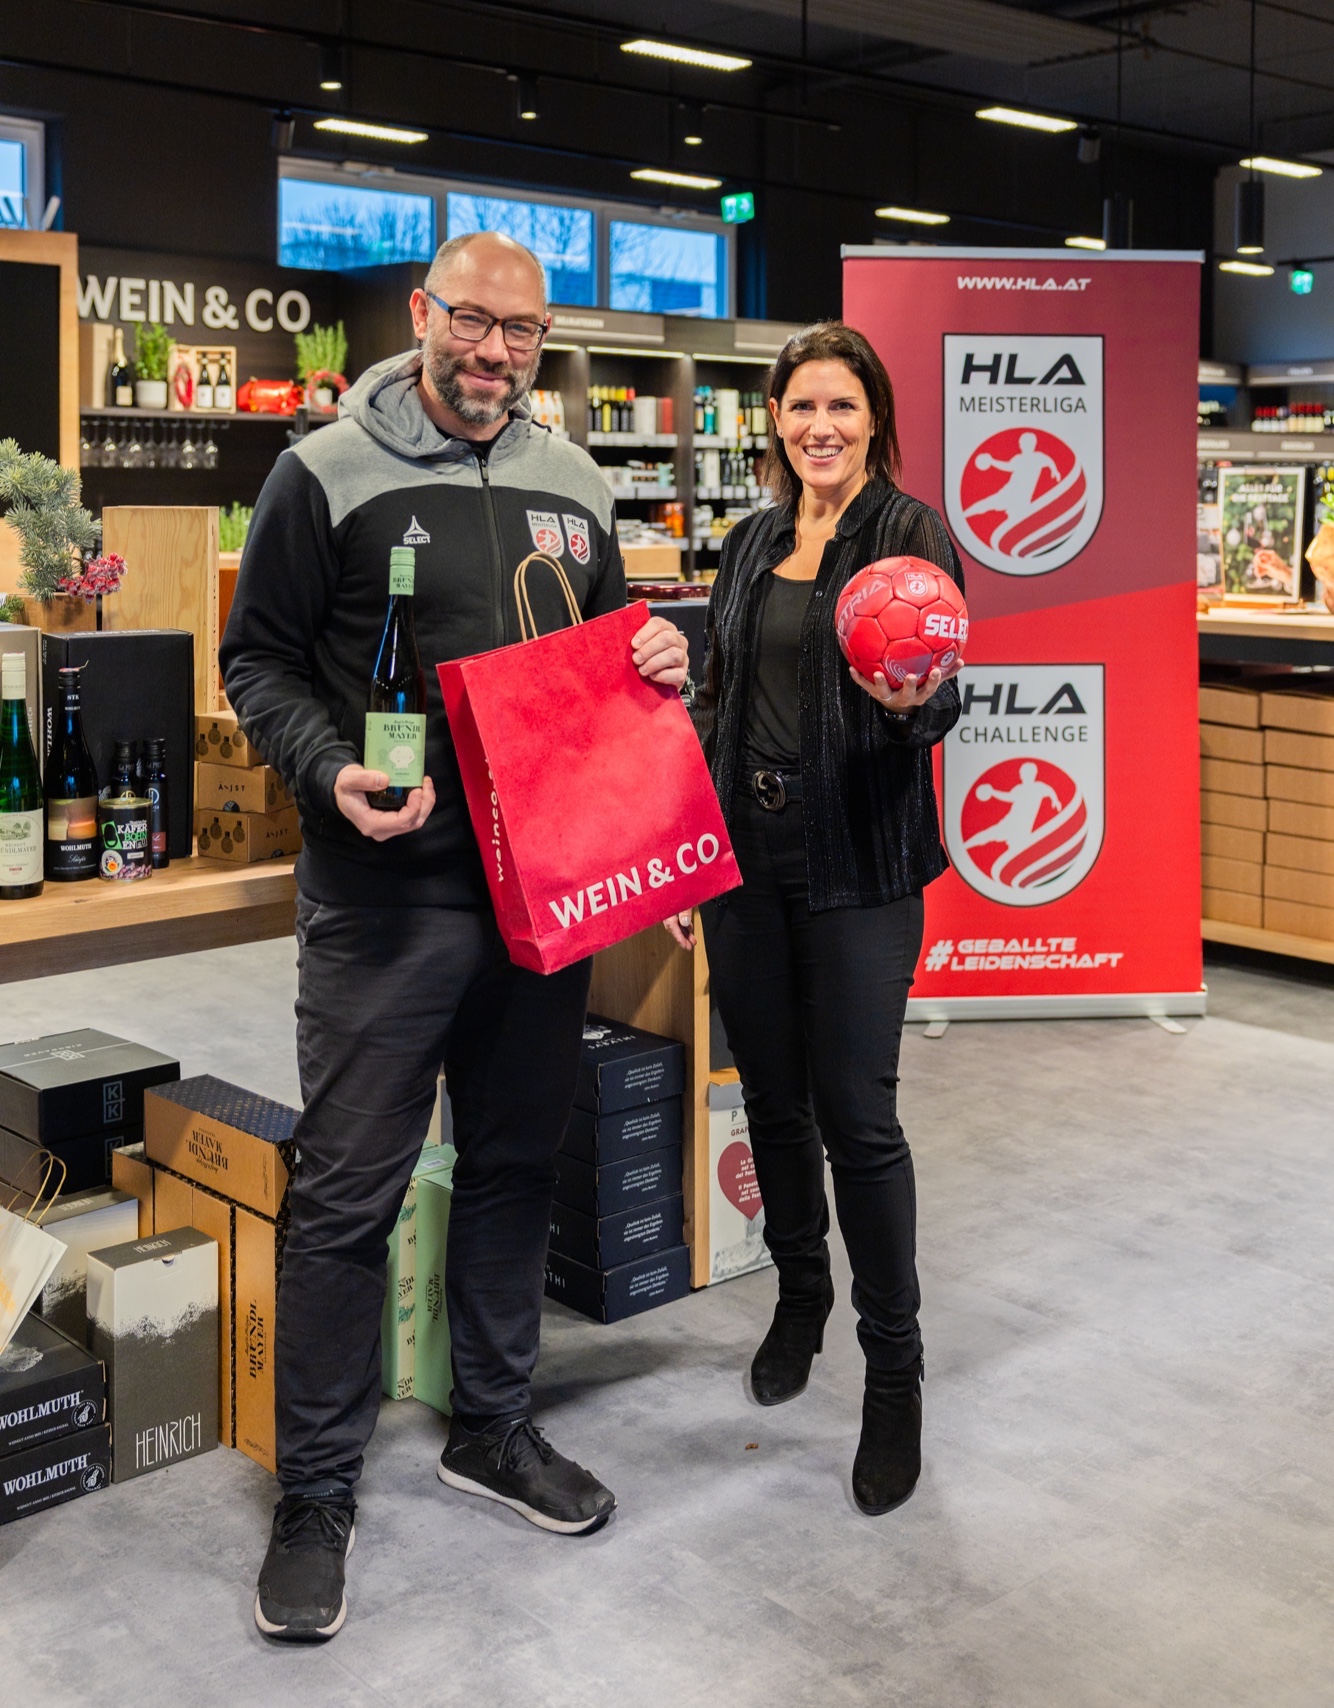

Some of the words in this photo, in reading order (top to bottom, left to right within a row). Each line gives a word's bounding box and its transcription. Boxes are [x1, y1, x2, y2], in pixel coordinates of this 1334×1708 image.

[957, 276, 1091, 291] WWW.HLA.AT
[77, 274, 194, 326] WEIN
[202, 286, 239, 330] &
[245, 288, 311, 332] CO
[960, 353, 1086, 385] HLA
[959, 396, 1087, 414] MEISTERLIGA
[531, 514, 556, 523] HLA
[567, 518, 585, 529] HLA
[403, 536, 430, 544] SELECT
[961, 682, 1086, 715] HLA
[959, 725, 1088, 743] CHALLENGE
[60, 843, 92, 851] WOHLMUTH
[549, 866, 642, 928] WEIN
[647, 858, 674, 888] &
[676, 833, 720, 875] CO
[950, 953, 1123, 971] LEIDENSCHAFT
[192, 1130, 222, 1153] MAYER
[0, 1390, 81, 1431] WOHLMUTH
[135, 1412, 201, 1469] HEINRICH
[3, 1453, 88, 1496] WOHLMUTH
